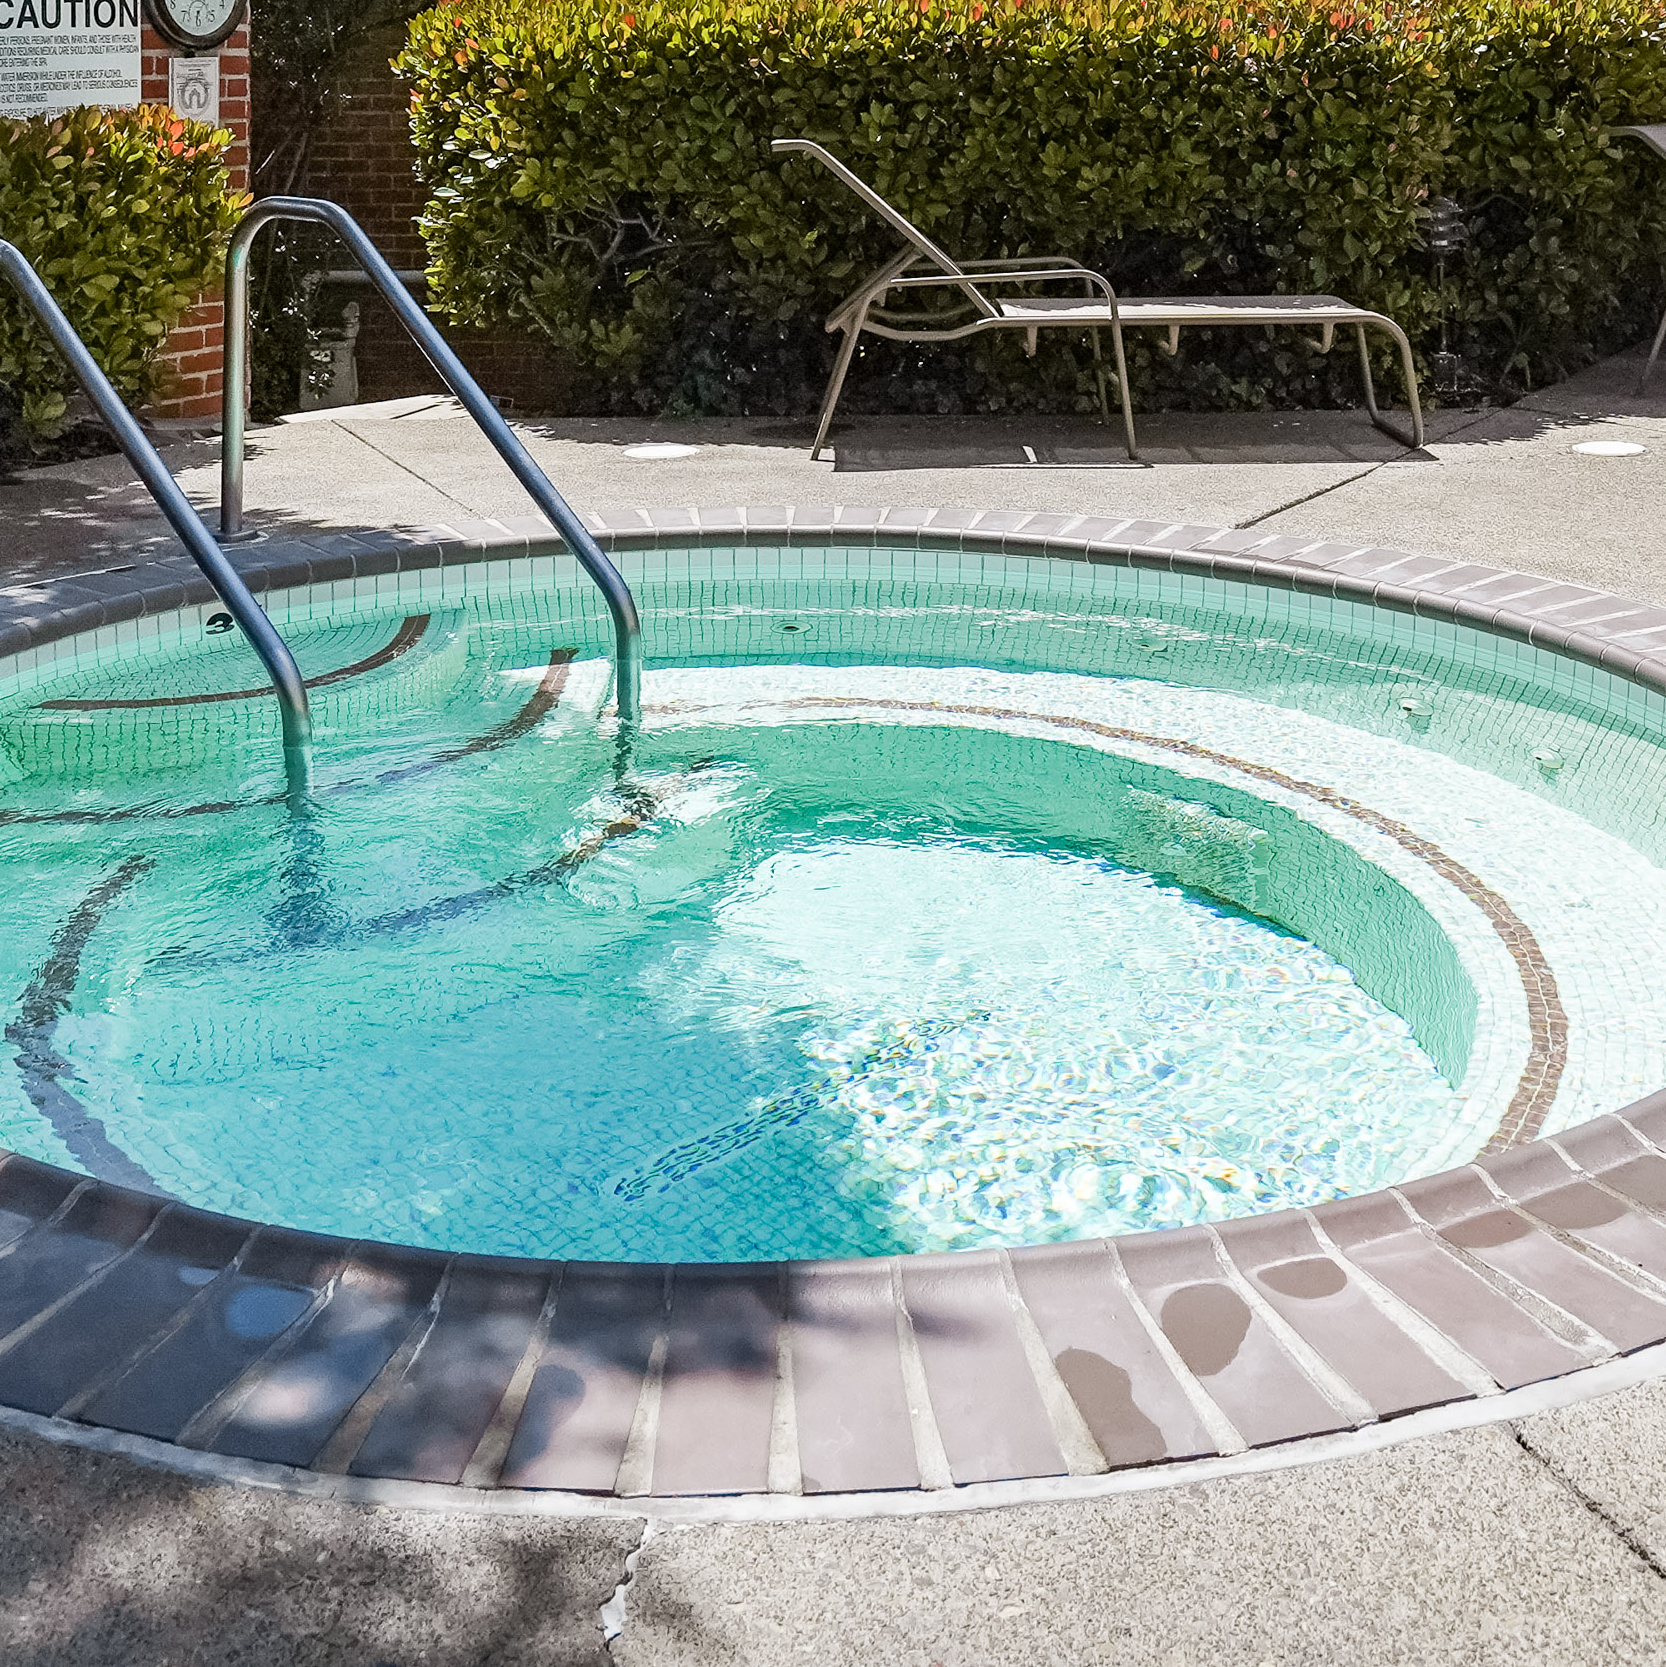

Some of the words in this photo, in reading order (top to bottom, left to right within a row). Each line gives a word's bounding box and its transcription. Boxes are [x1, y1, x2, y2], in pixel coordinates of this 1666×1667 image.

[180, 10, 188, 23] 7
[195, 11, 202, 27] 6
[208, 10, 215, 23] 5
[206, 612, 235, 635] 3
